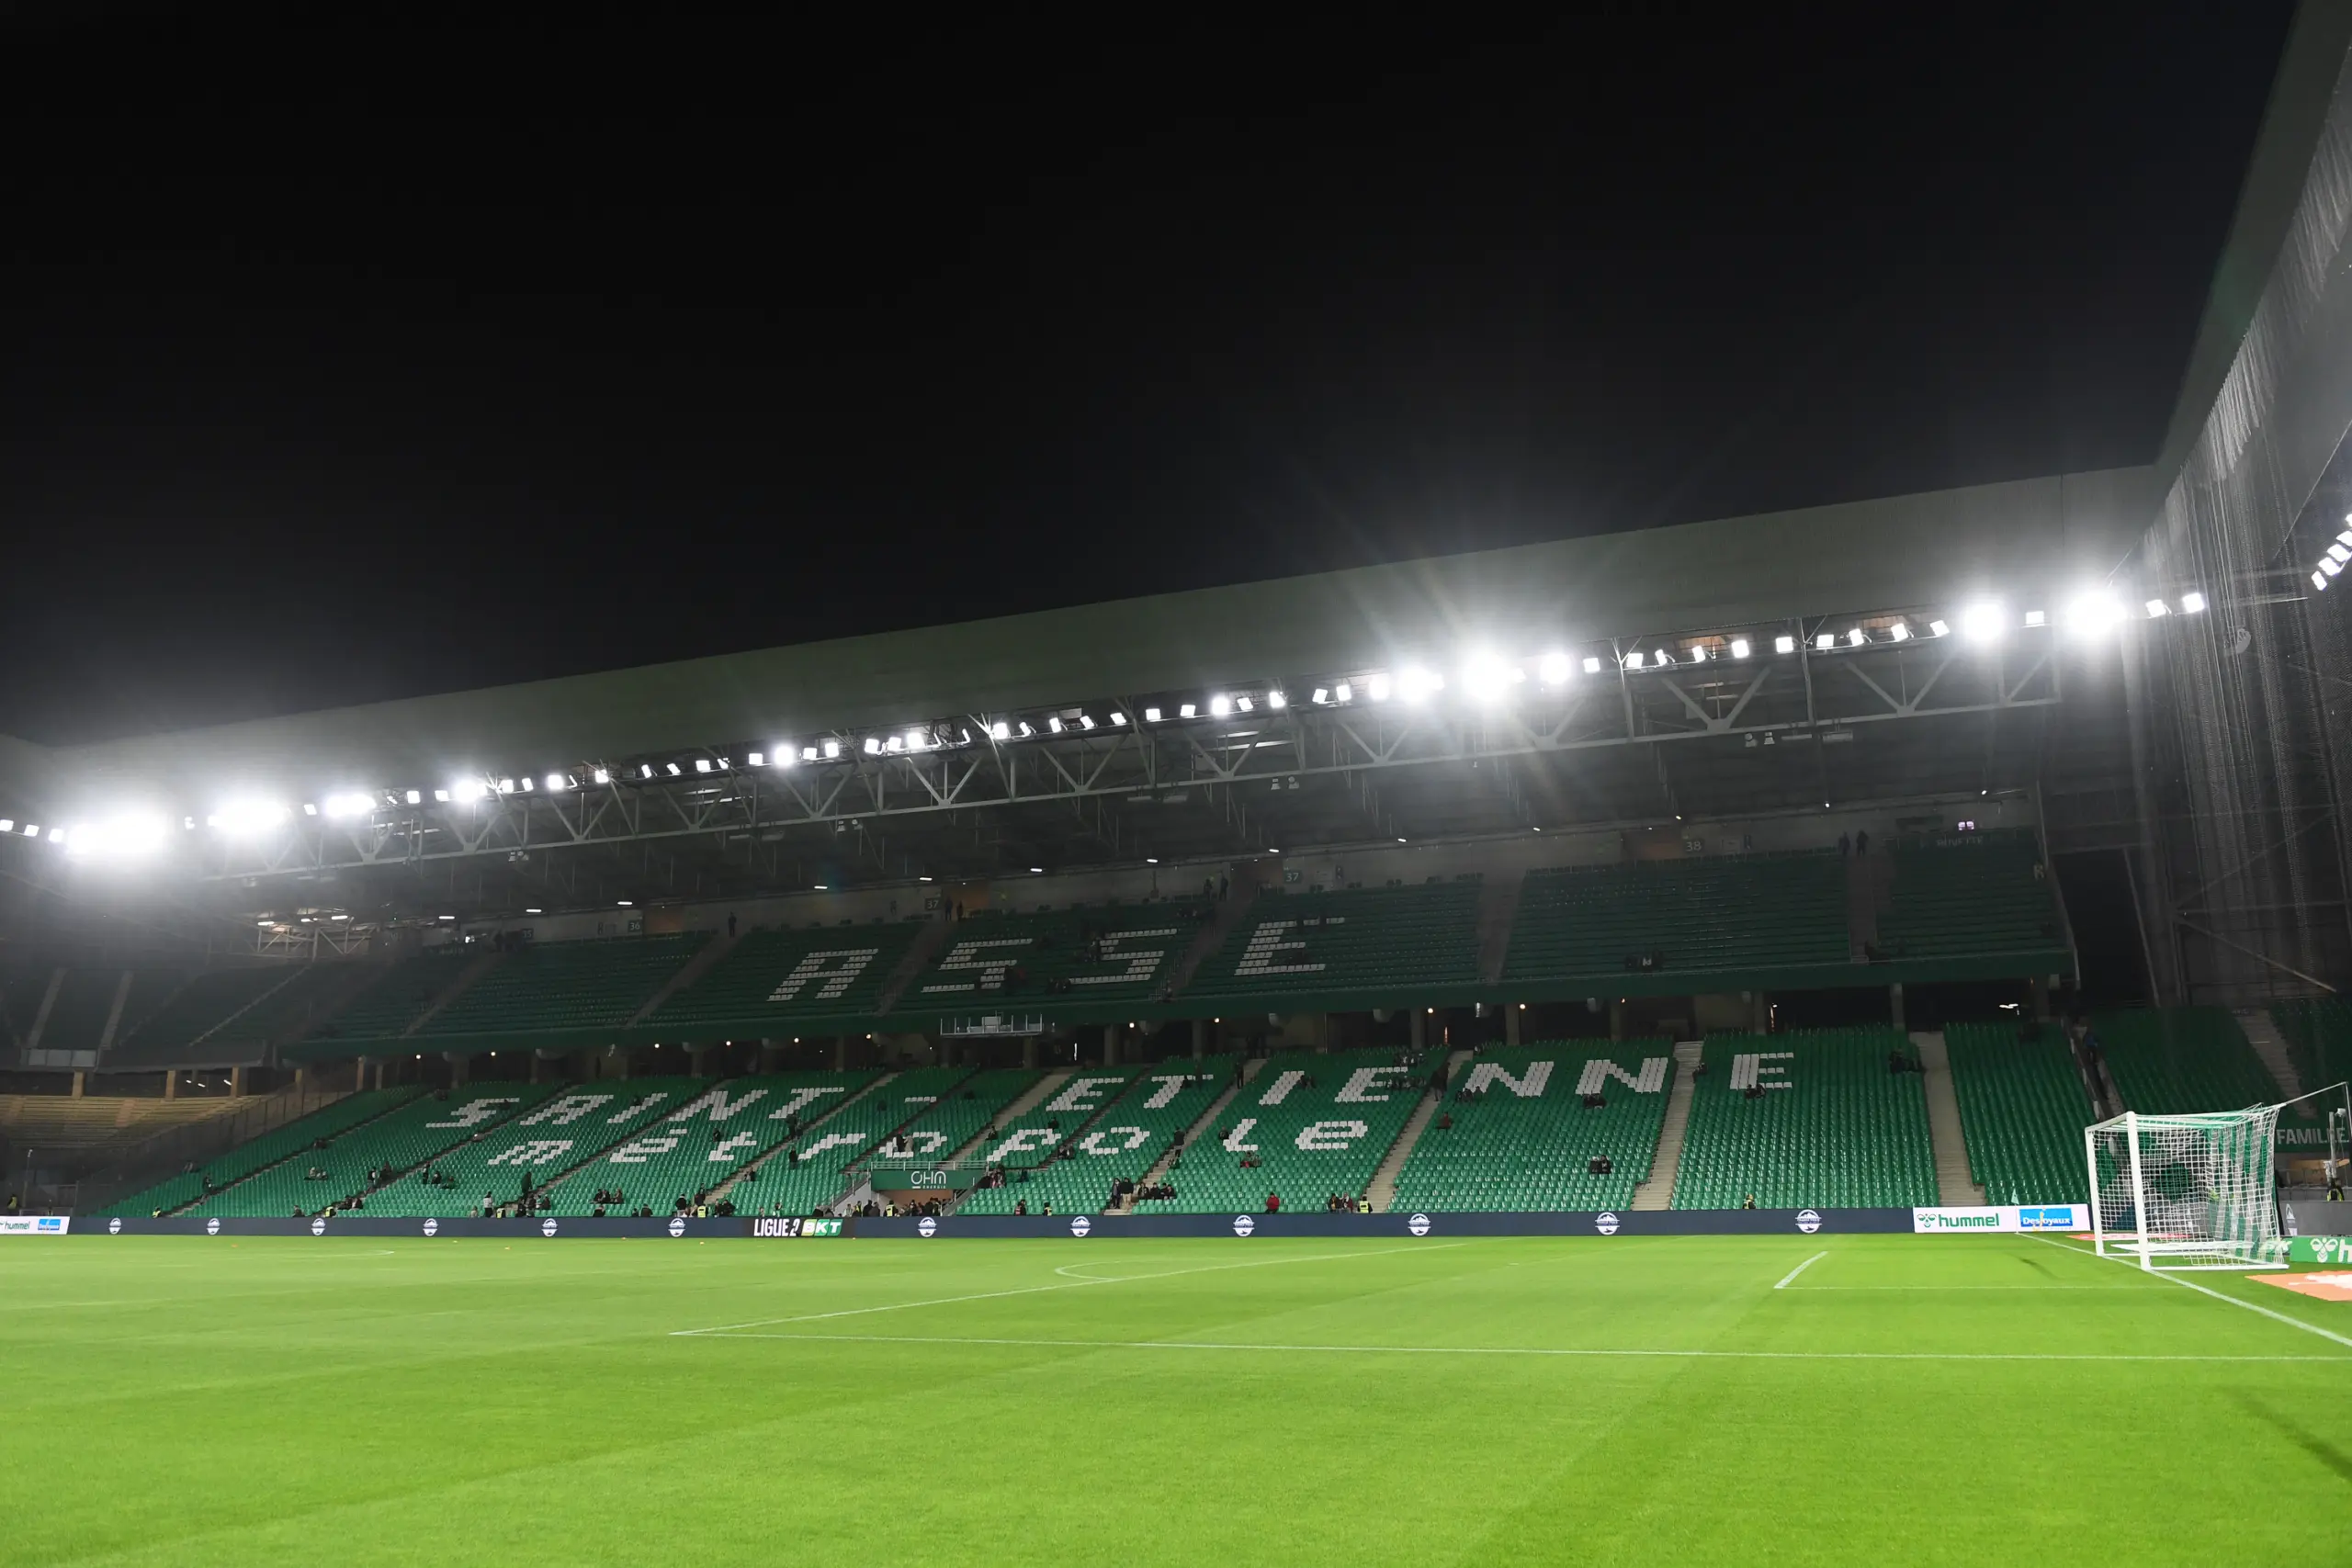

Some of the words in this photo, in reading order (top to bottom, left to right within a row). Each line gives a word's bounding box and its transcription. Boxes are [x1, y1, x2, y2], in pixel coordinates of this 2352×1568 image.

[1685, 840, 1702, 852] 38
[1286, 872, 1300, 883] 37
[927, 899, 939, 909] 37
[629, 921, 641, 931] 36
[766, 917, 1345, 1002] ASSE
[4, 1221, 31, 1230] hummel
[1939, 1213, 2000, 1228] hummel
[753, 1218, 789, 1237] LIGUE
[789, 1218, 800, 1237] 2
[802, 1220, 842, 1235] BKT
